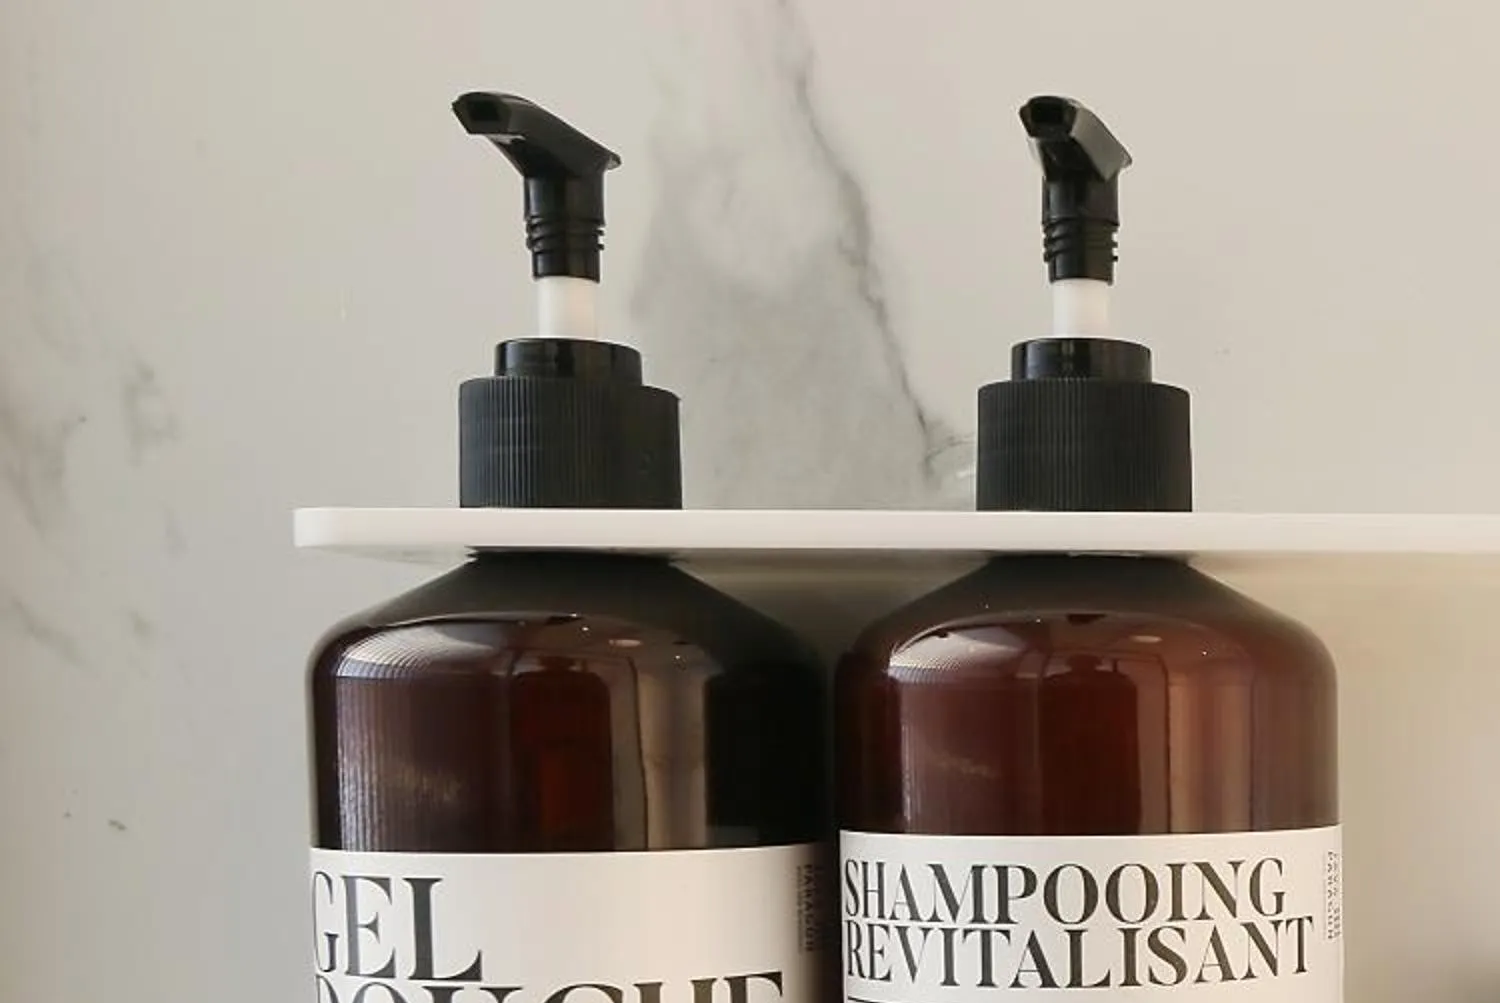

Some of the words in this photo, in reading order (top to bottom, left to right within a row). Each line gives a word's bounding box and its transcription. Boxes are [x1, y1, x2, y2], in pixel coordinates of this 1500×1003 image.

[312, 870, 482, 983] GEL
[844, 857, 1286, 925] SHAMPOOING
[845, 916, 1314, 989] REVITALISANT
